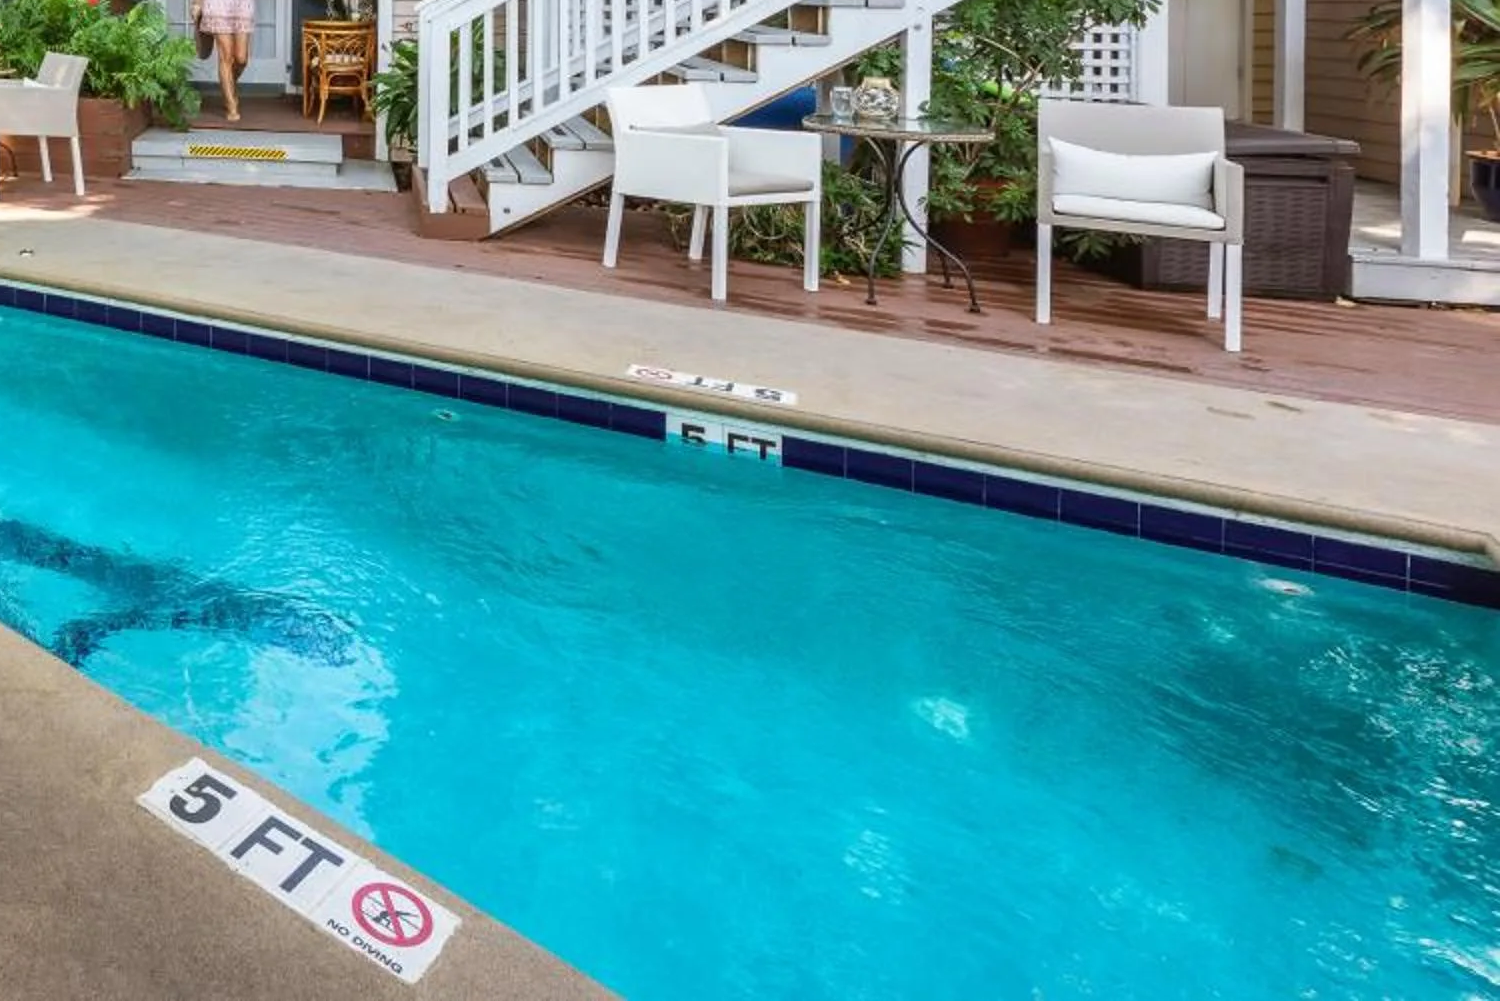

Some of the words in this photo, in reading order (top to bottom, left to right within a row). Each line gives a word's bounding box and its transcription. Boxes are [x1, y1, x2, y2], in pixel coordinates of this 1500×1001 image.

[727, 432, 777, 460] FT
[169, 774, 238, 824] 5
[229, 815, 344, 893] FT
[326, 918, 350, 936] NO
[352, 936, 403, 974] DIVING
